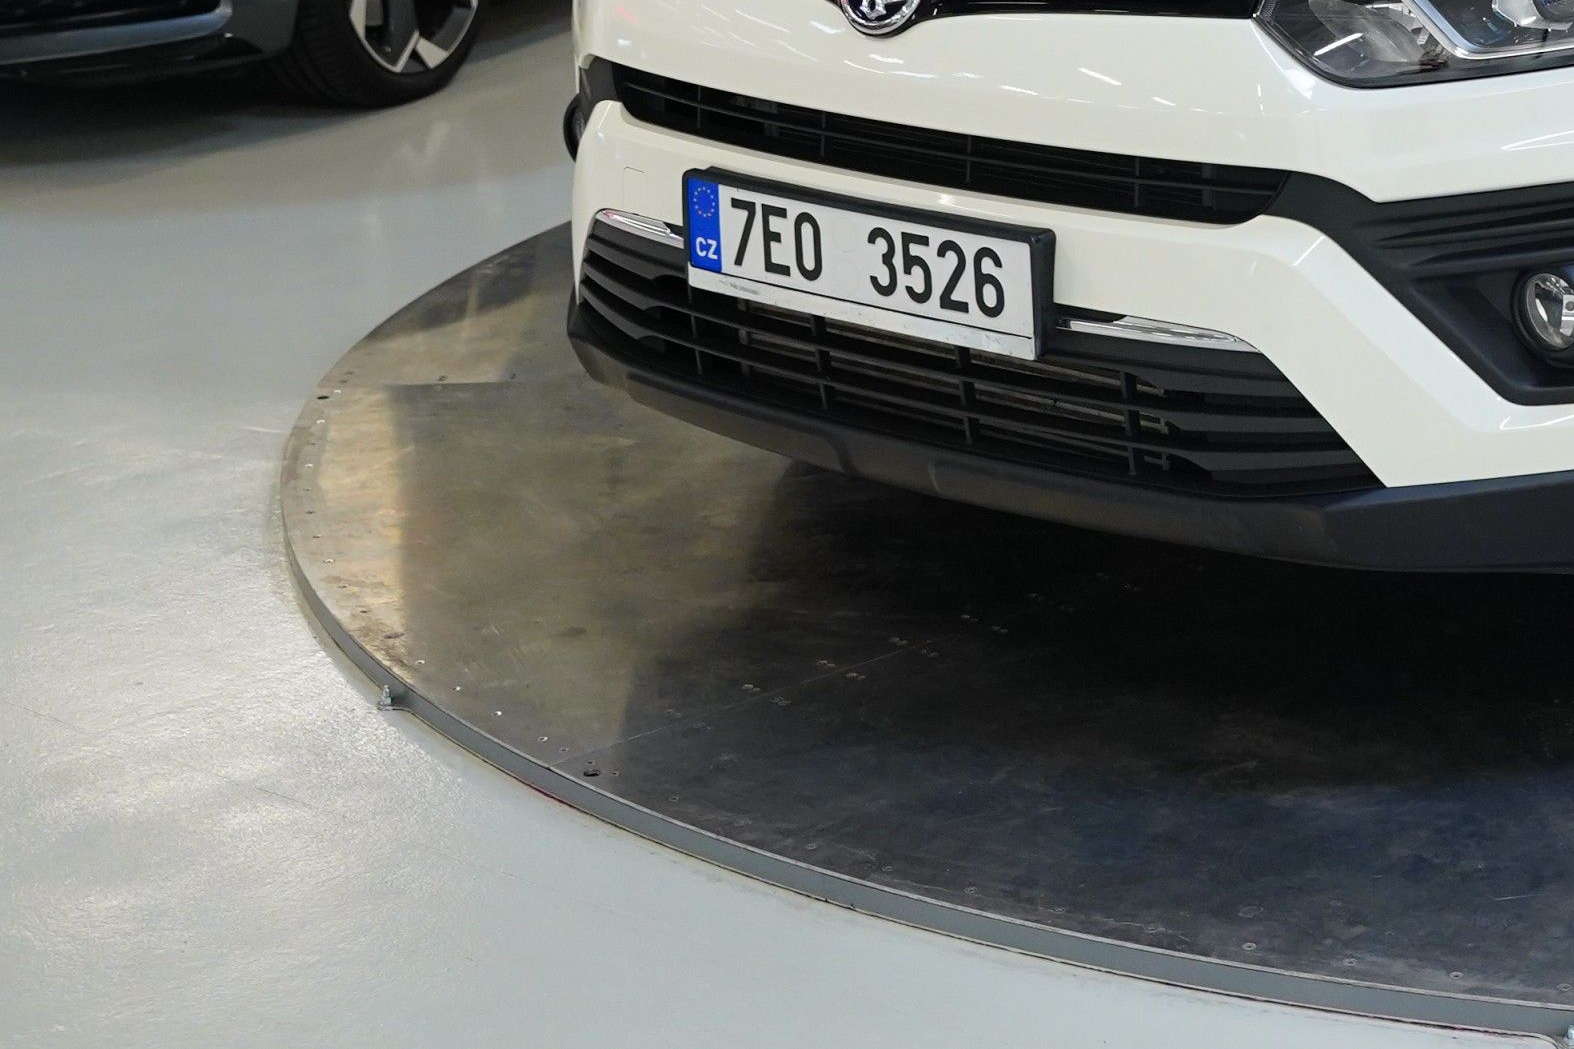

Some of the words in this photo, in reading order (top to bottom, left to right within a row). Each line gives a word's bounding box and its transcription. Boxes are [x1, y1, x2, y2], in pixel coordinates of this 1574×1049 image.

[695, 236, 719, 261] CZ
[731, 198, 822, 281] 7E0
[867, 227, 1005, 318] 3526
